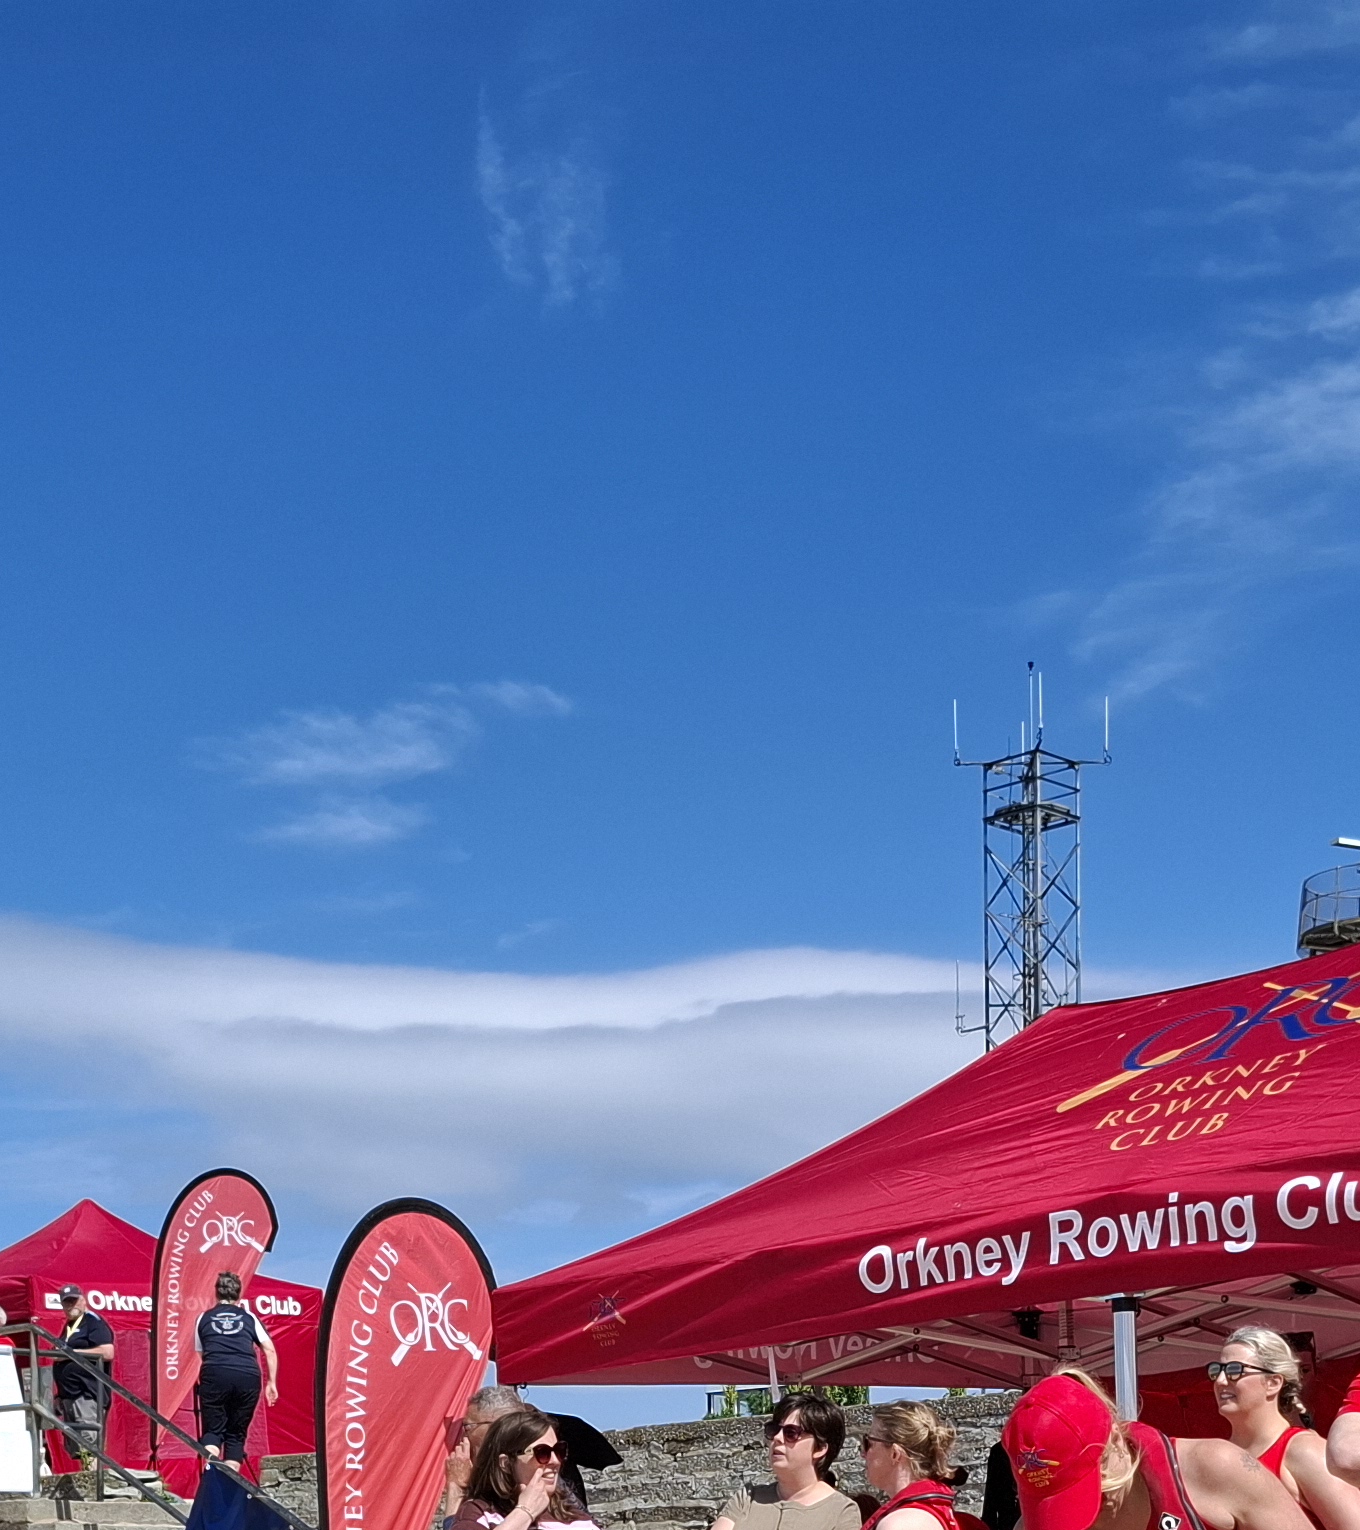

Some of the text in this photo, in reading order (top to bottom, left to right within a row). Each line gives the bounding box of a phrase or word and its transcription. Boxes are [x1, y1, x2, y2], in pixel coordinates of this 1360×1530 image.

[1094, 1072, 1302, 1130] ROWING
[1128, 1044, 1327, 1102] ORKNEY
[1109, 1112, 1230, 1151] CLUB
[203, 1216, 255, 1247] ORC
[859, 1230, 1031, 1293] Orkney
[1048, 1192, 1256, 1264] Rowing
[88, 1290, 153, 1311] Orkne
[256, 1295, 302, 1316] Club
[166, 1190, 214, 1380] ORKNEY ROWING CLUB
[390, 1292, 470, 1351] ORC
[345, 1320, 373, 1471] ROWING
[359, 1242, 399, 1315] CLUB
